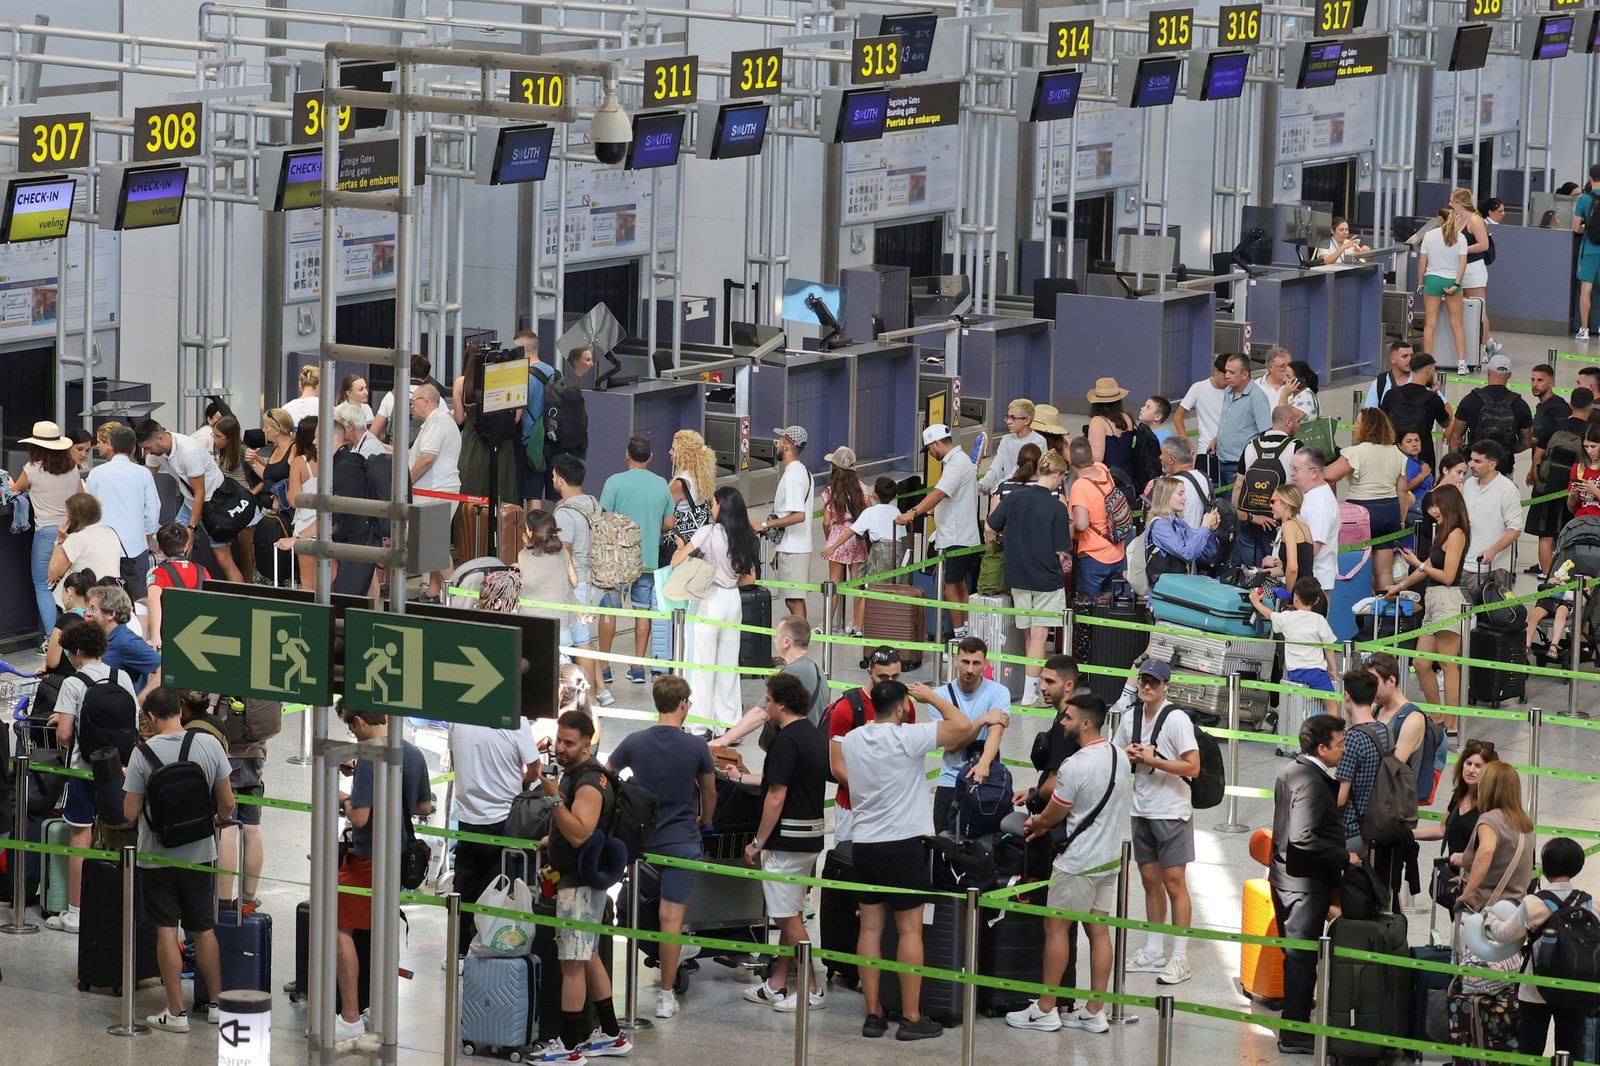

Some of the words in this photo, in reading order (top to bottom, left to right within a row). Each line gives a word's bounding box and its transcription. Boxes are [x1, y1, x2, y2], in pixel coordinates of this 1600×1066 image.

[1157, 15, 1189, 46] 315
[1227, 10, 1258, 41] 316
[1322, 1, 1351, 31] 317
[1057, 26, 1090, 58] 314
[740, 55, 779, 91] 312
[861, 42, 897, 76] 313
[522, 76, 562, 107] 310
[653, 63, 691, 100] 311
[146, 111, 197, 152] 308
[304, 99, 351, 136] 39
[886, 118, 906, 128] Puertas
[907, 116, 914, 125] de
[915, 114, 940, 124] embarque
[31, 122, 85, 163] 307
[361, 154, 376, 164] Gates
[131, 178, 172, 193] CHECK-IN
[359, 177, 368, 187] de
[17, 191, 59, 205] CHECK-IN
[152, 204, 178, 217] vueling
[38, 216, 65, 230] vueling
